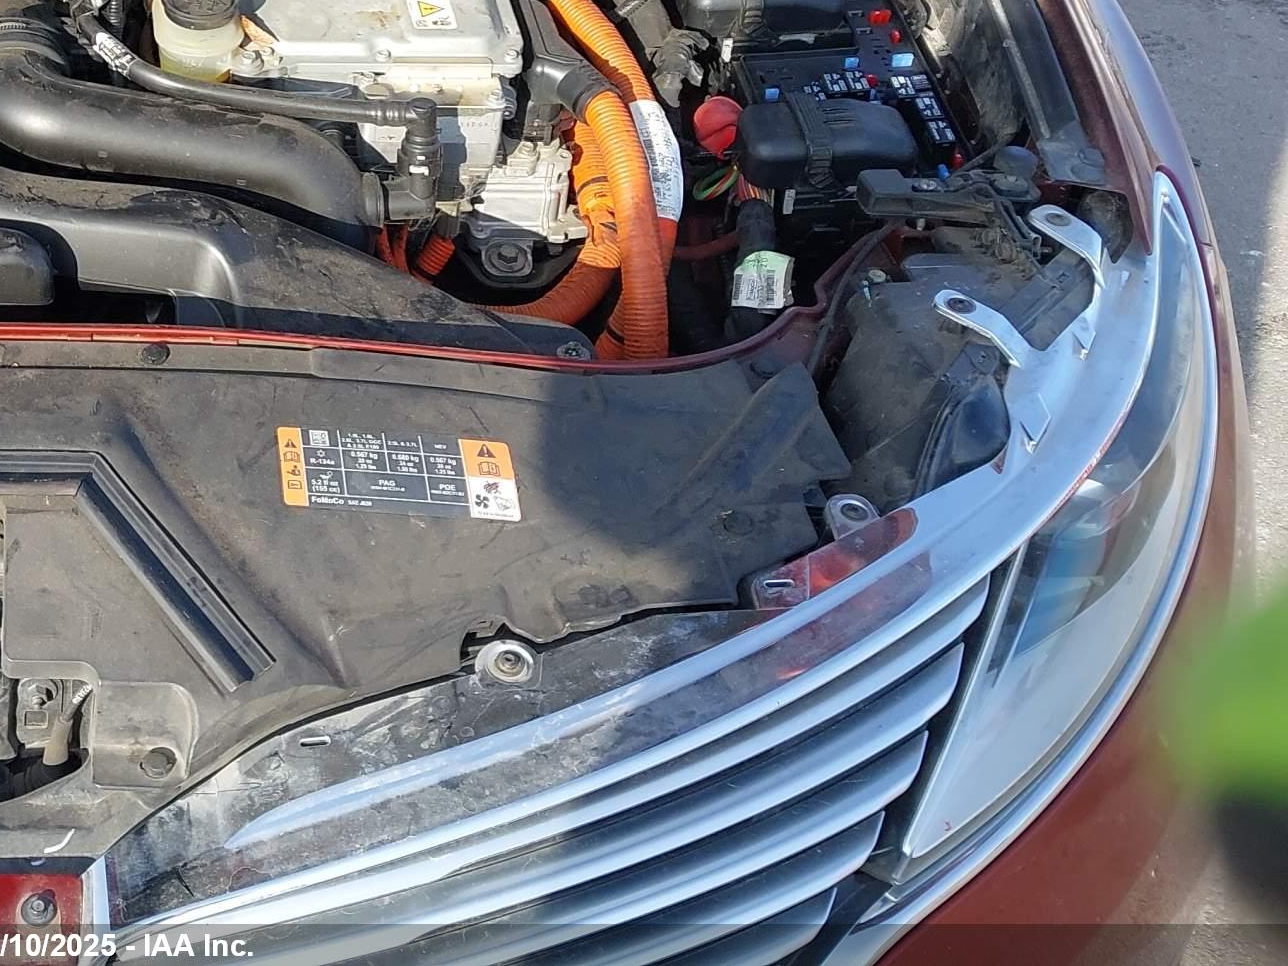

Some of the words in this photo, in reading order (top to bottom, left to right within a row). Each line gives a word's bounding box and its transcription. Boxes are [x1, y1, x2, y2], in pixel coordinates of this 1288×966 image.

[310, 457, 335, 466] R-134a
[378, 479, 396, 487] PAG
[439, 483, 456, 491] POE
[312, 496, 344, 505] FoMoCo
